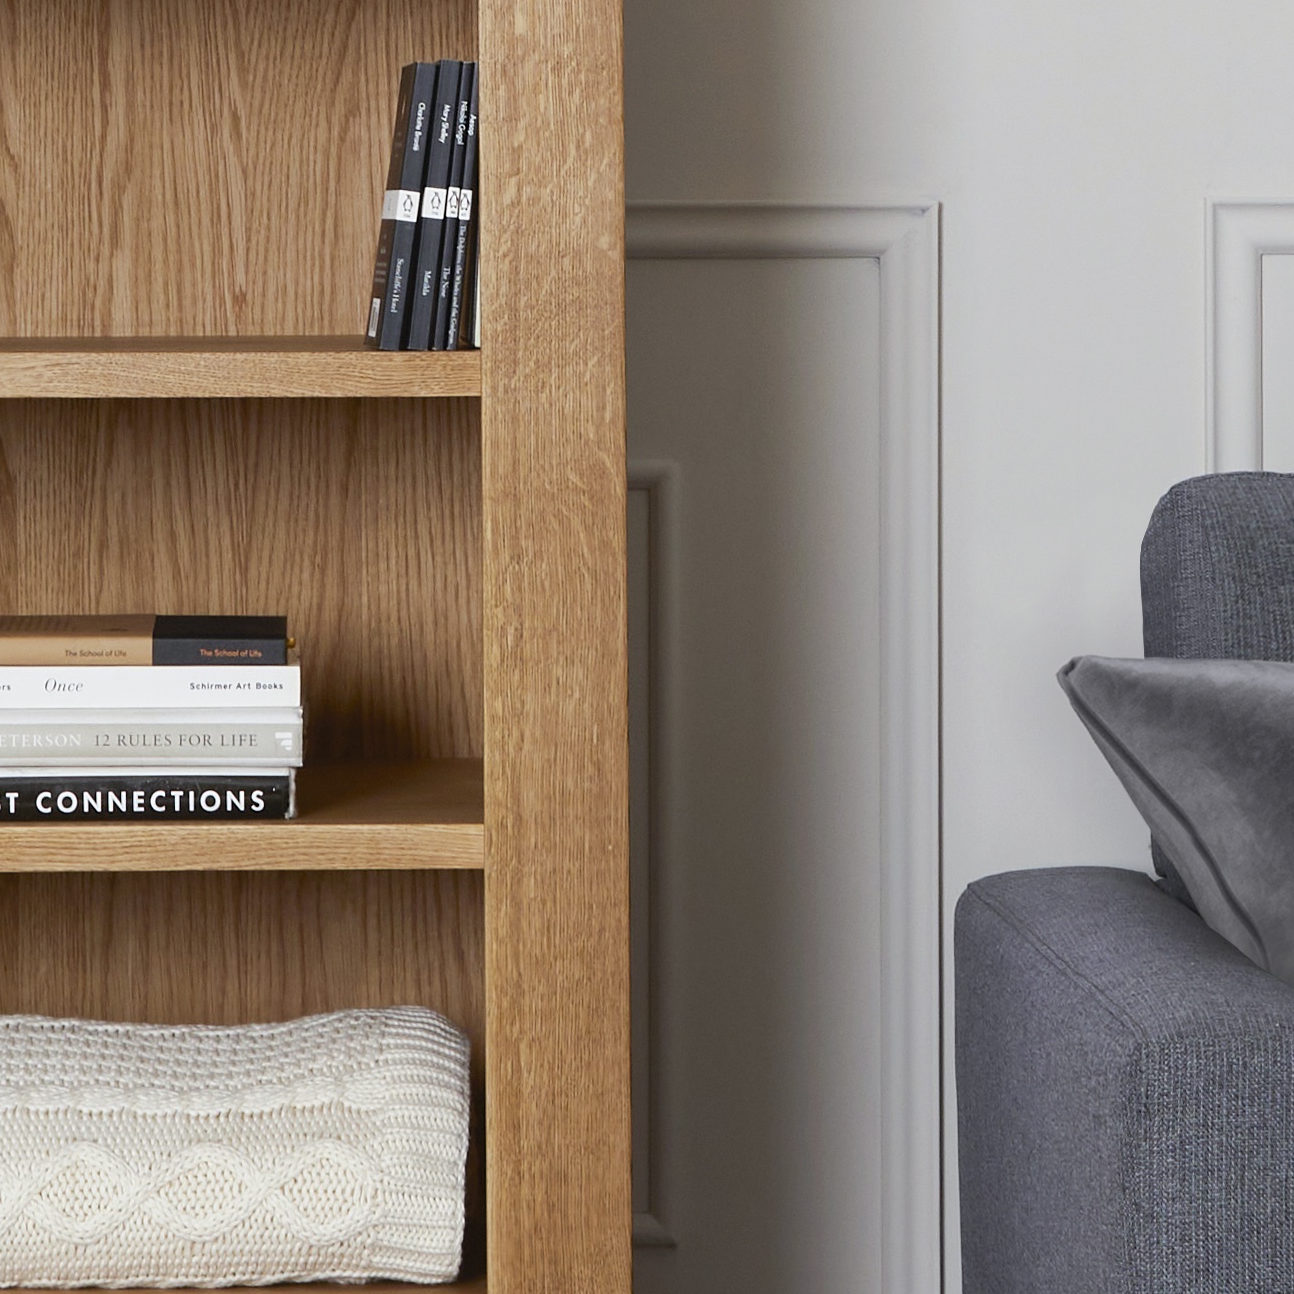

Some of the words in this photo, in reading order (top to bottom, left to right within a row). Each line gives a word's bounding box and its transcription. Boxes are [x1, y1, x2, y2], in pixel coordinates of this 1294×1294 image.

[440, 103, 451, 121] Mary
[65, 649, 77, 657] The
[79, 649, 104, 657] School
[105, 649, 113, 657] of
[114, 649, 127, 657] Life
[199, 648, 213, 657] The
[214, 648, 239, 657] School
[240, 649, 248, 657] of
[249, 649, 263, 658] Life
[44, 677, 84, 693] Once
[189, 682, 232, 690] Schirmer
[235, 682, 251, 690] Art
[255, 682, 284, 690] Books
[94, 734, 110, 747] 12
[117, 734, 172, 747] RULES
[178, 734, 213, 747] FOR
[220, 734, 258, 747] LIFE
[35, 790, 266, 814] CONNECTIONS
